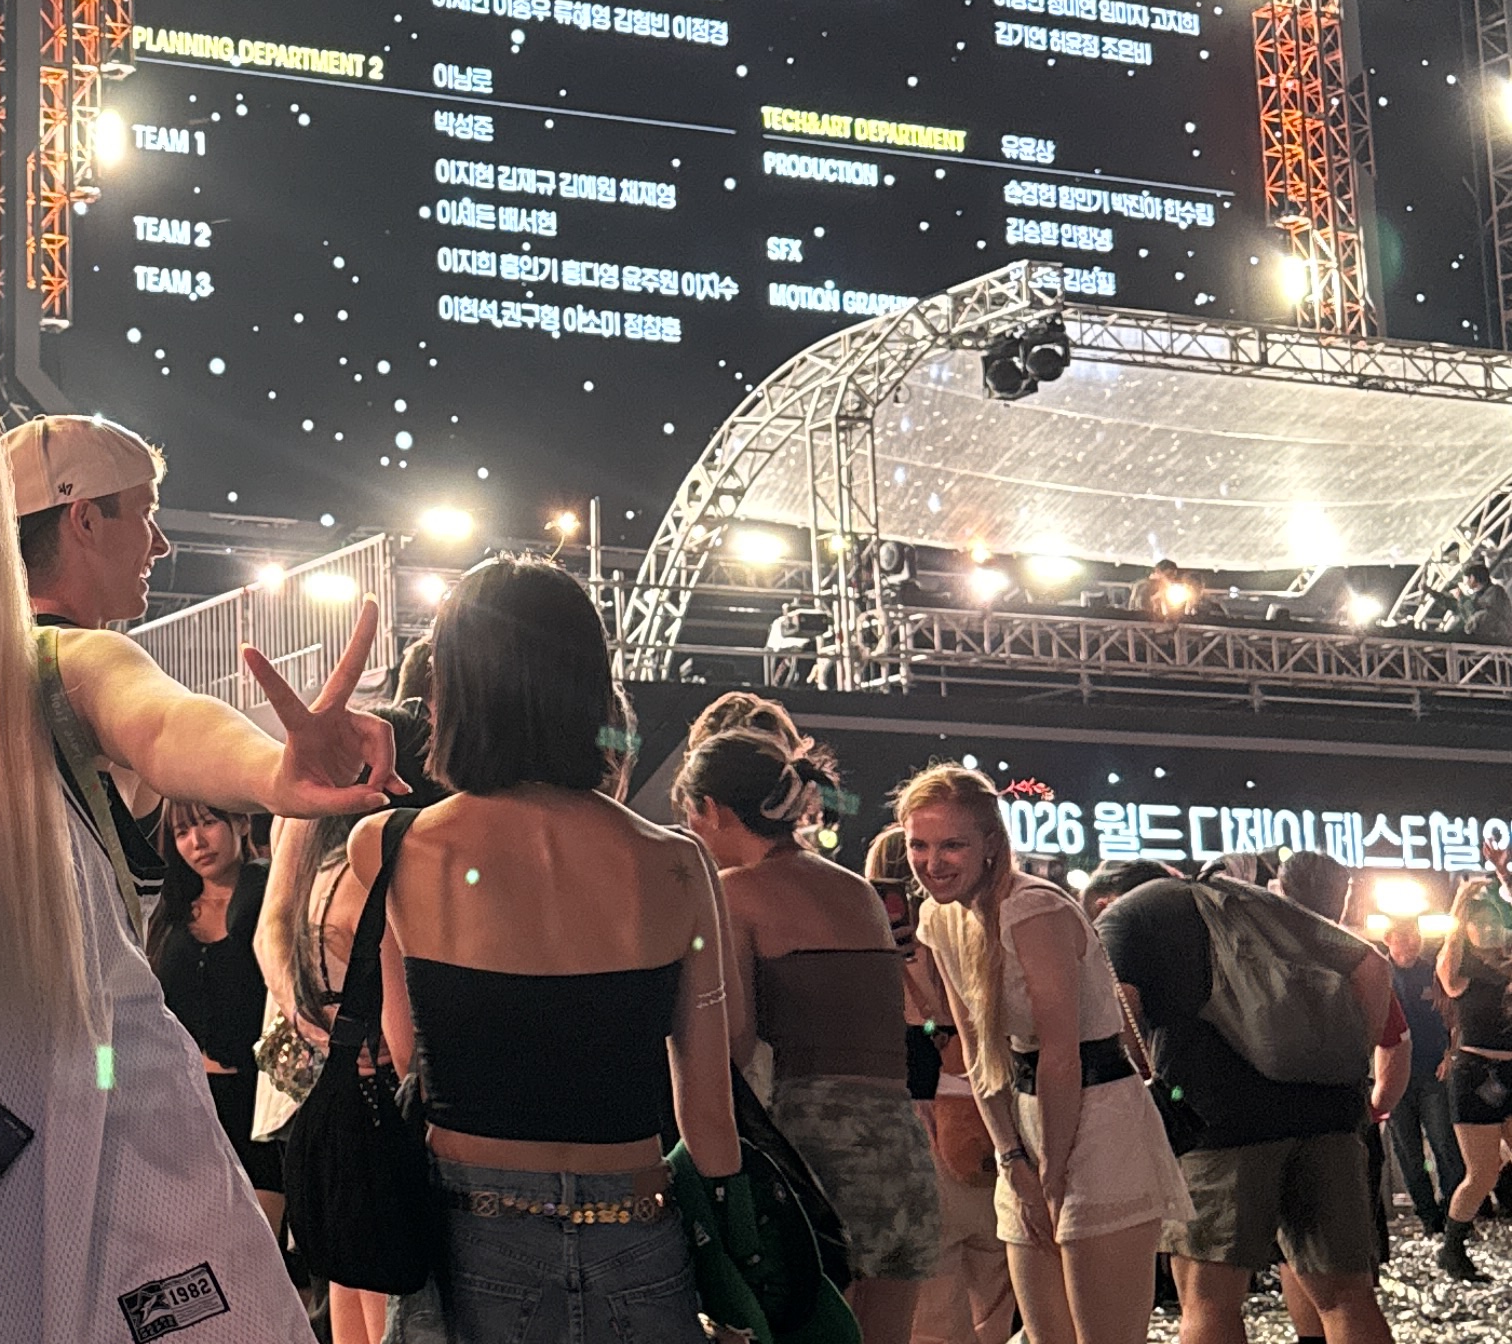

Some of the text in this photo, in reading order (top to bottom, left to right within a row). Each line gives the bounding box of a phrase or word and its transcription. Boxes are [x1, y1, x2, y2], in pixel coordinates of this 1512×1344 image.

[133, 25, 384, 80] PLANNING DEPARTMENT 2
[133, 124, 205, 155] TEAM 1
[761, 106, 966, 153] TECH&ART DEPARTMENT
[764, 151, 878, 187] PRODUCTION
[134, 215, 211, 247] TEAM 2
[767, 236, 803, 263] SFX
[134, 265, 213, 297] TEAM 3
[770, 283, 839, 312] MOTION
[997, 800, 1085, 854] 026
[1094, 801, 1186, 861] 월드
[1322, 810, 1481, 871] 페스티벌
[169, 1278, 212, 1305] 1982
